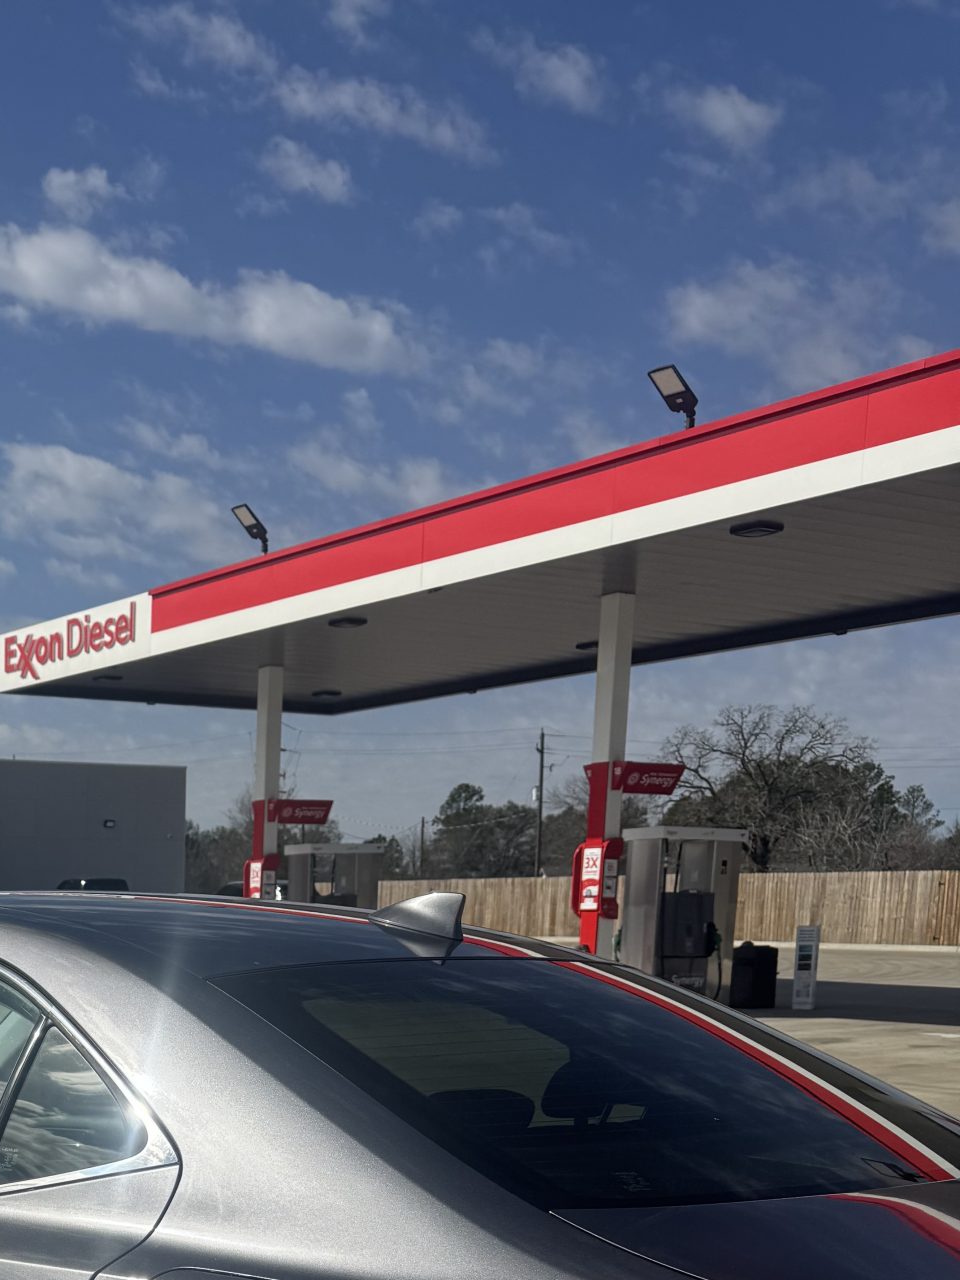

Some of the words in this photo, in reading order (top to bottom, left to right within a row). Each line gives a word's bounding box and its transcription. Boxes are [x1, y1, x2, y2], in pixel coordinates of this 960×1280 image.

[4, 632, 64, 680] Exxon
[67, 601, 136, 659] Diesel
[640, 773, 676, 788] Synergy
[584, 856, 599, 870] 3X
